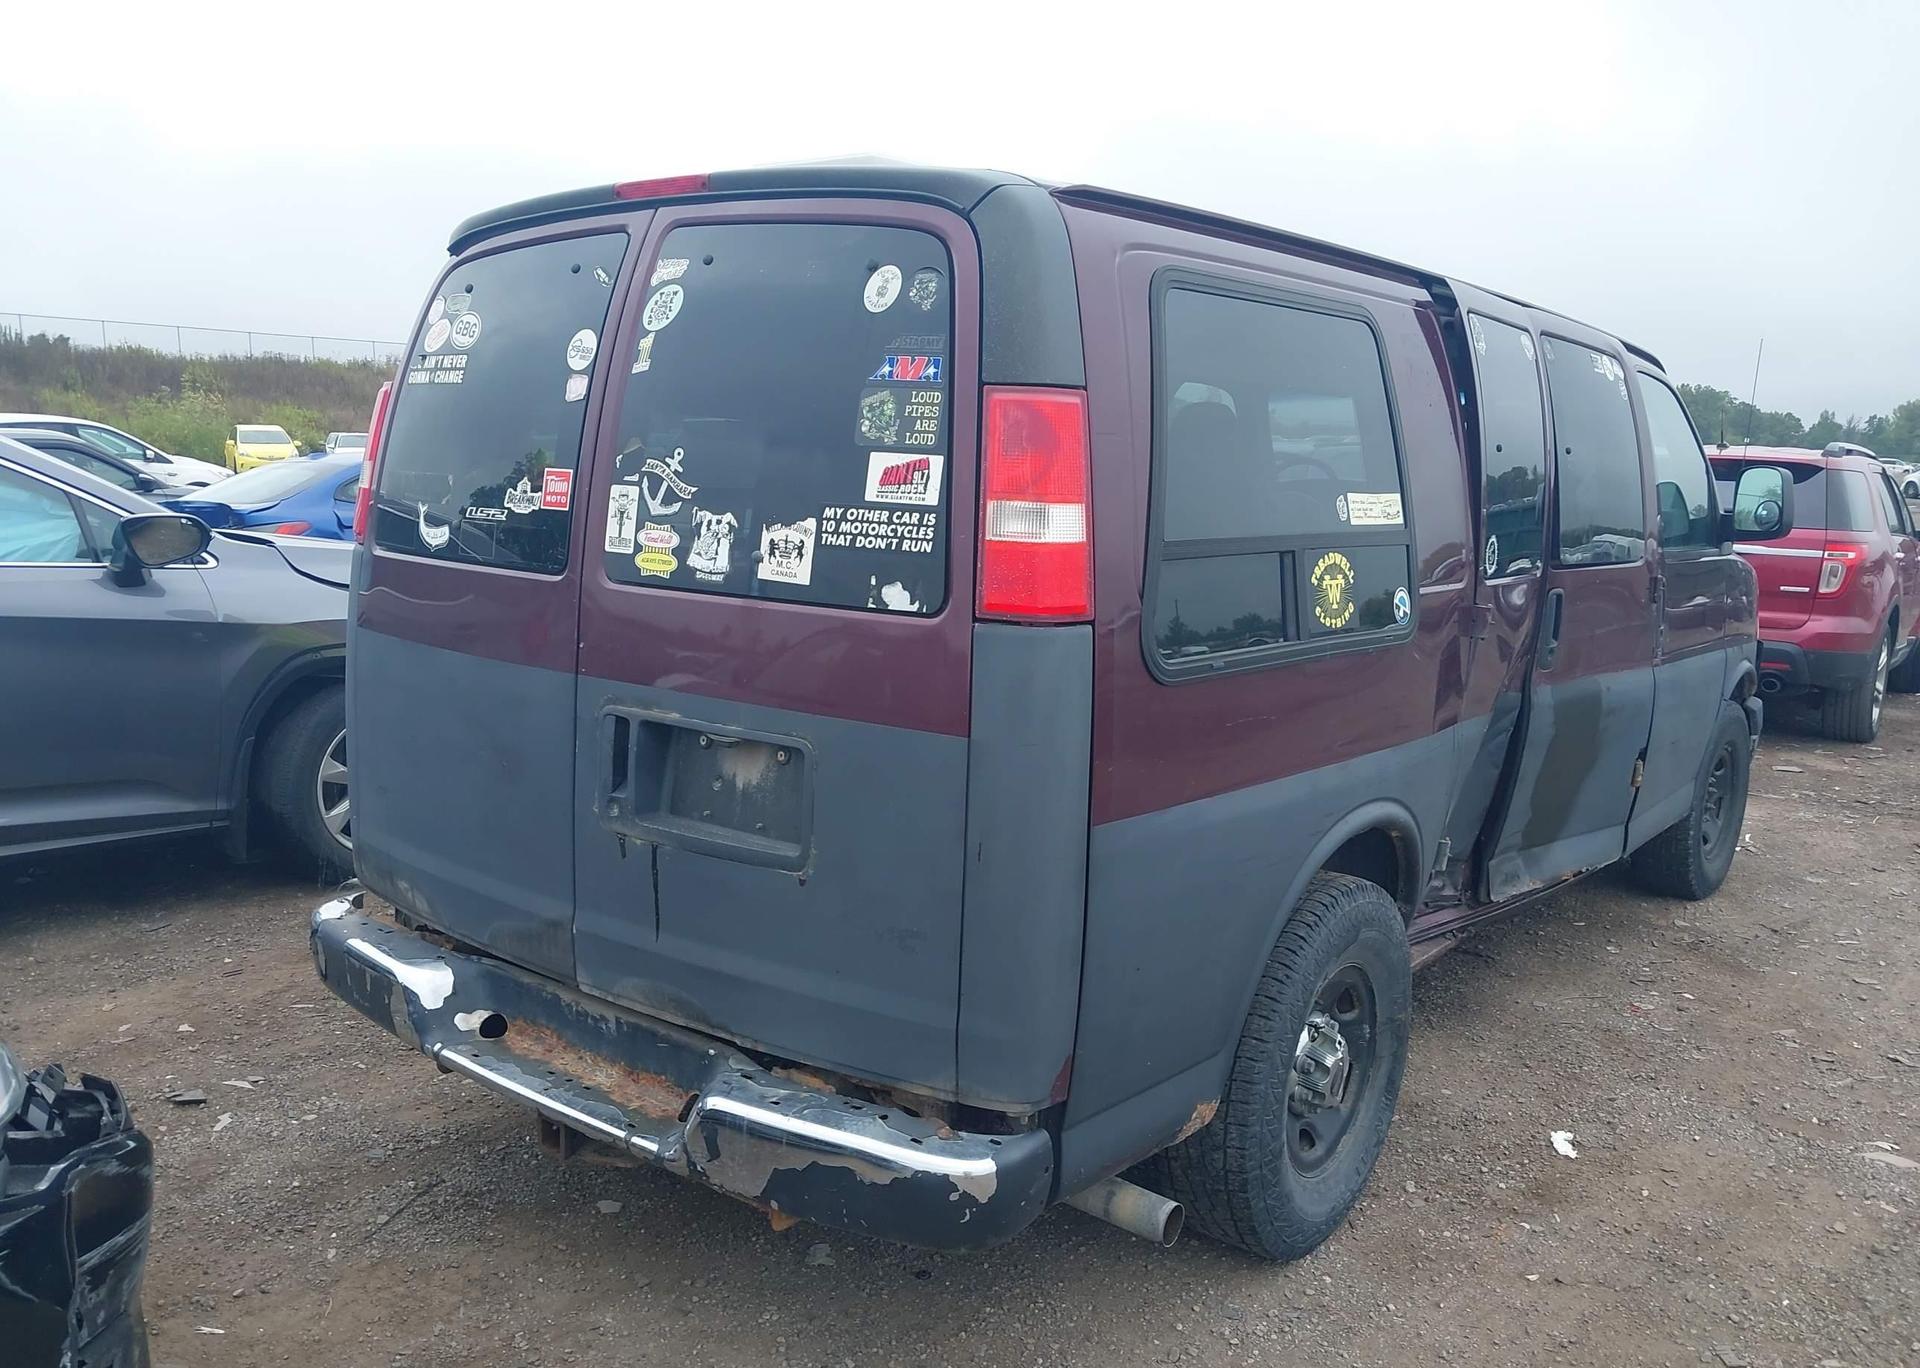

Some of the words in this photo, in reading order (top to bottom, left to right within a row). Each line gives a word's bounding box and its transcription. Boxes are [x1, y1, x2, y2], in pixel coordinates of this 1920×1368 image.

[455, 319, 478, 338] GBG
[423, 355, 444, 369] AIN'T
[442, 354, 468, 368] NEVER
[868, 355, 944, 382] AMA
[408, 371, 430, 384] GONNA
[434, 370, 465, 384] CHANGE
[911, 391, 942, 403] LOUD
[904, 405, 940, 417] PIPES
[914, 419, 938, 431] ARE
[905, 433, 936, 445] LOUD
[879, 461, 915, 486] GIANT
[913, 470, 929, 484] 91.7
[665, 471, 692, 497] BARBARA
[900, 484, 928, 495] ROCK
[545, 495, 567, 503] MOTO
[875, 493, 927, 502] WWW.GIANTFM.COM
[466, 507, 508, 520] LS2
[822, 506, 845, 520] MY
[846, 508, 890, 523] OTHER
[892, 511, 921, 525] CAR
[922, 513, 937, 526] IS
[822, 520, 836, 533] 10
[838, 521, 935, 540] MOTORCYCLES
[821, 533, 853, 547] THAT
[855, 536, 899, 551] DON'T
[901, 539, 933, 553] RUN
[776, 560, 794, 570] M.C.
[1311, 552, 1355, 586] TREADWELL
[770, 569, 798, 579] CANADA
[1315, 602, 1355, 629] CLOTHING
